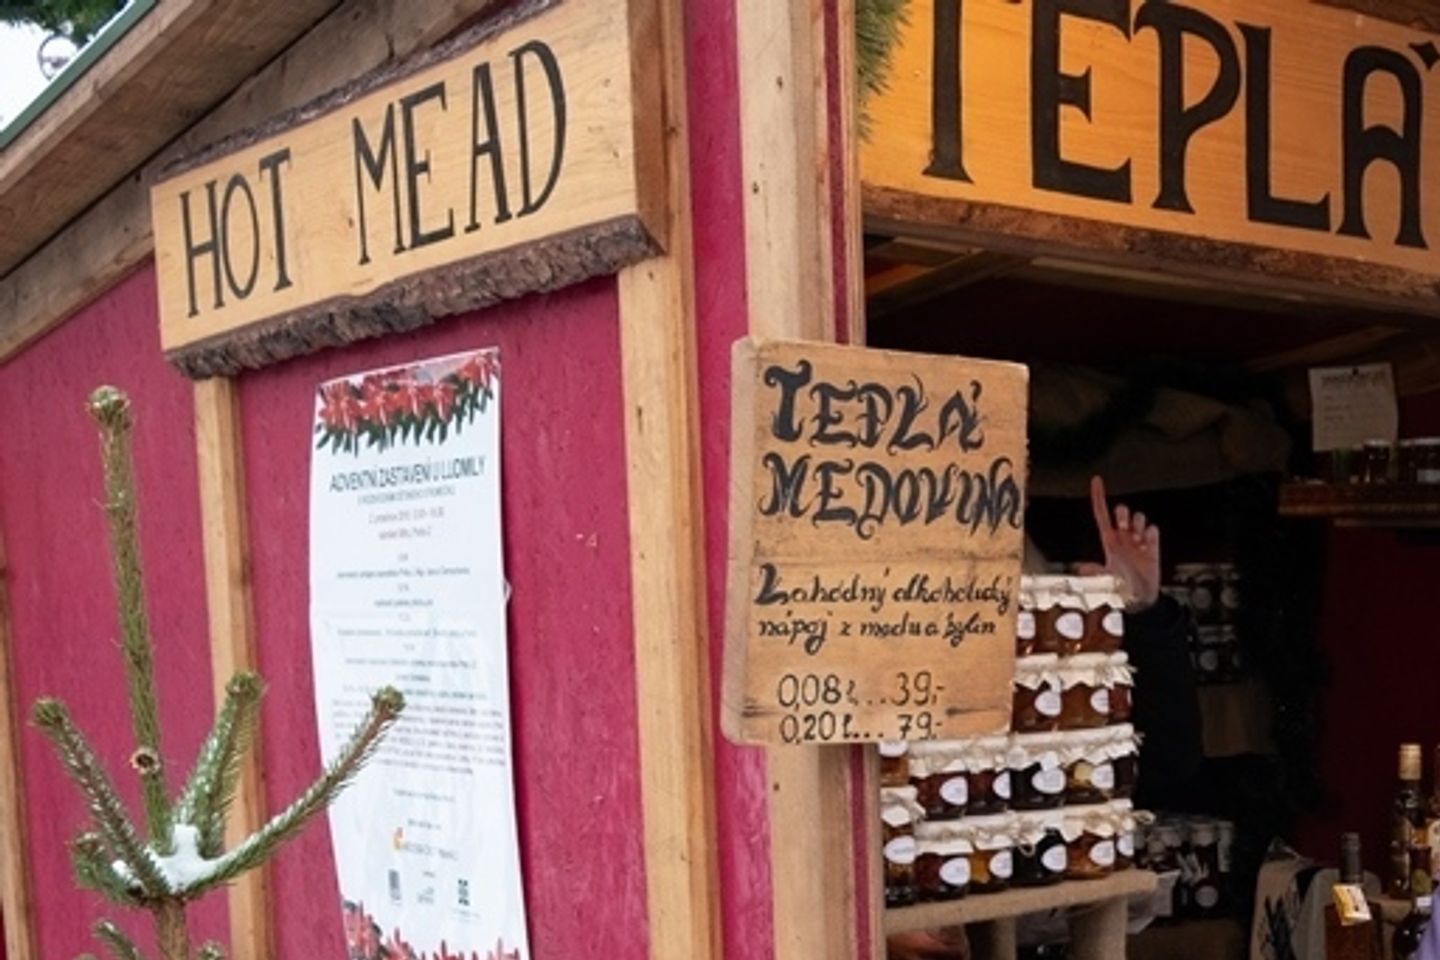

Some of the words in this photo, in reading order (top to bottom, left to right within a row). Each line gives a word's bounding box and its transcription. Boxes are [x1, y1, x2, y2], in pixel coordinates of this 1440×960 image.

[179, 148, 292, 318] HOT
[351, 39, 568, 265] MEAD
[764, 359, 985, 455] TEPLÁ
[758, 452, 1023, 540] MEDOVINA
[758, 611, 834, 656] nápoj
[839, 621, 852, 637] z
[860, 611, 921, 638] medu
